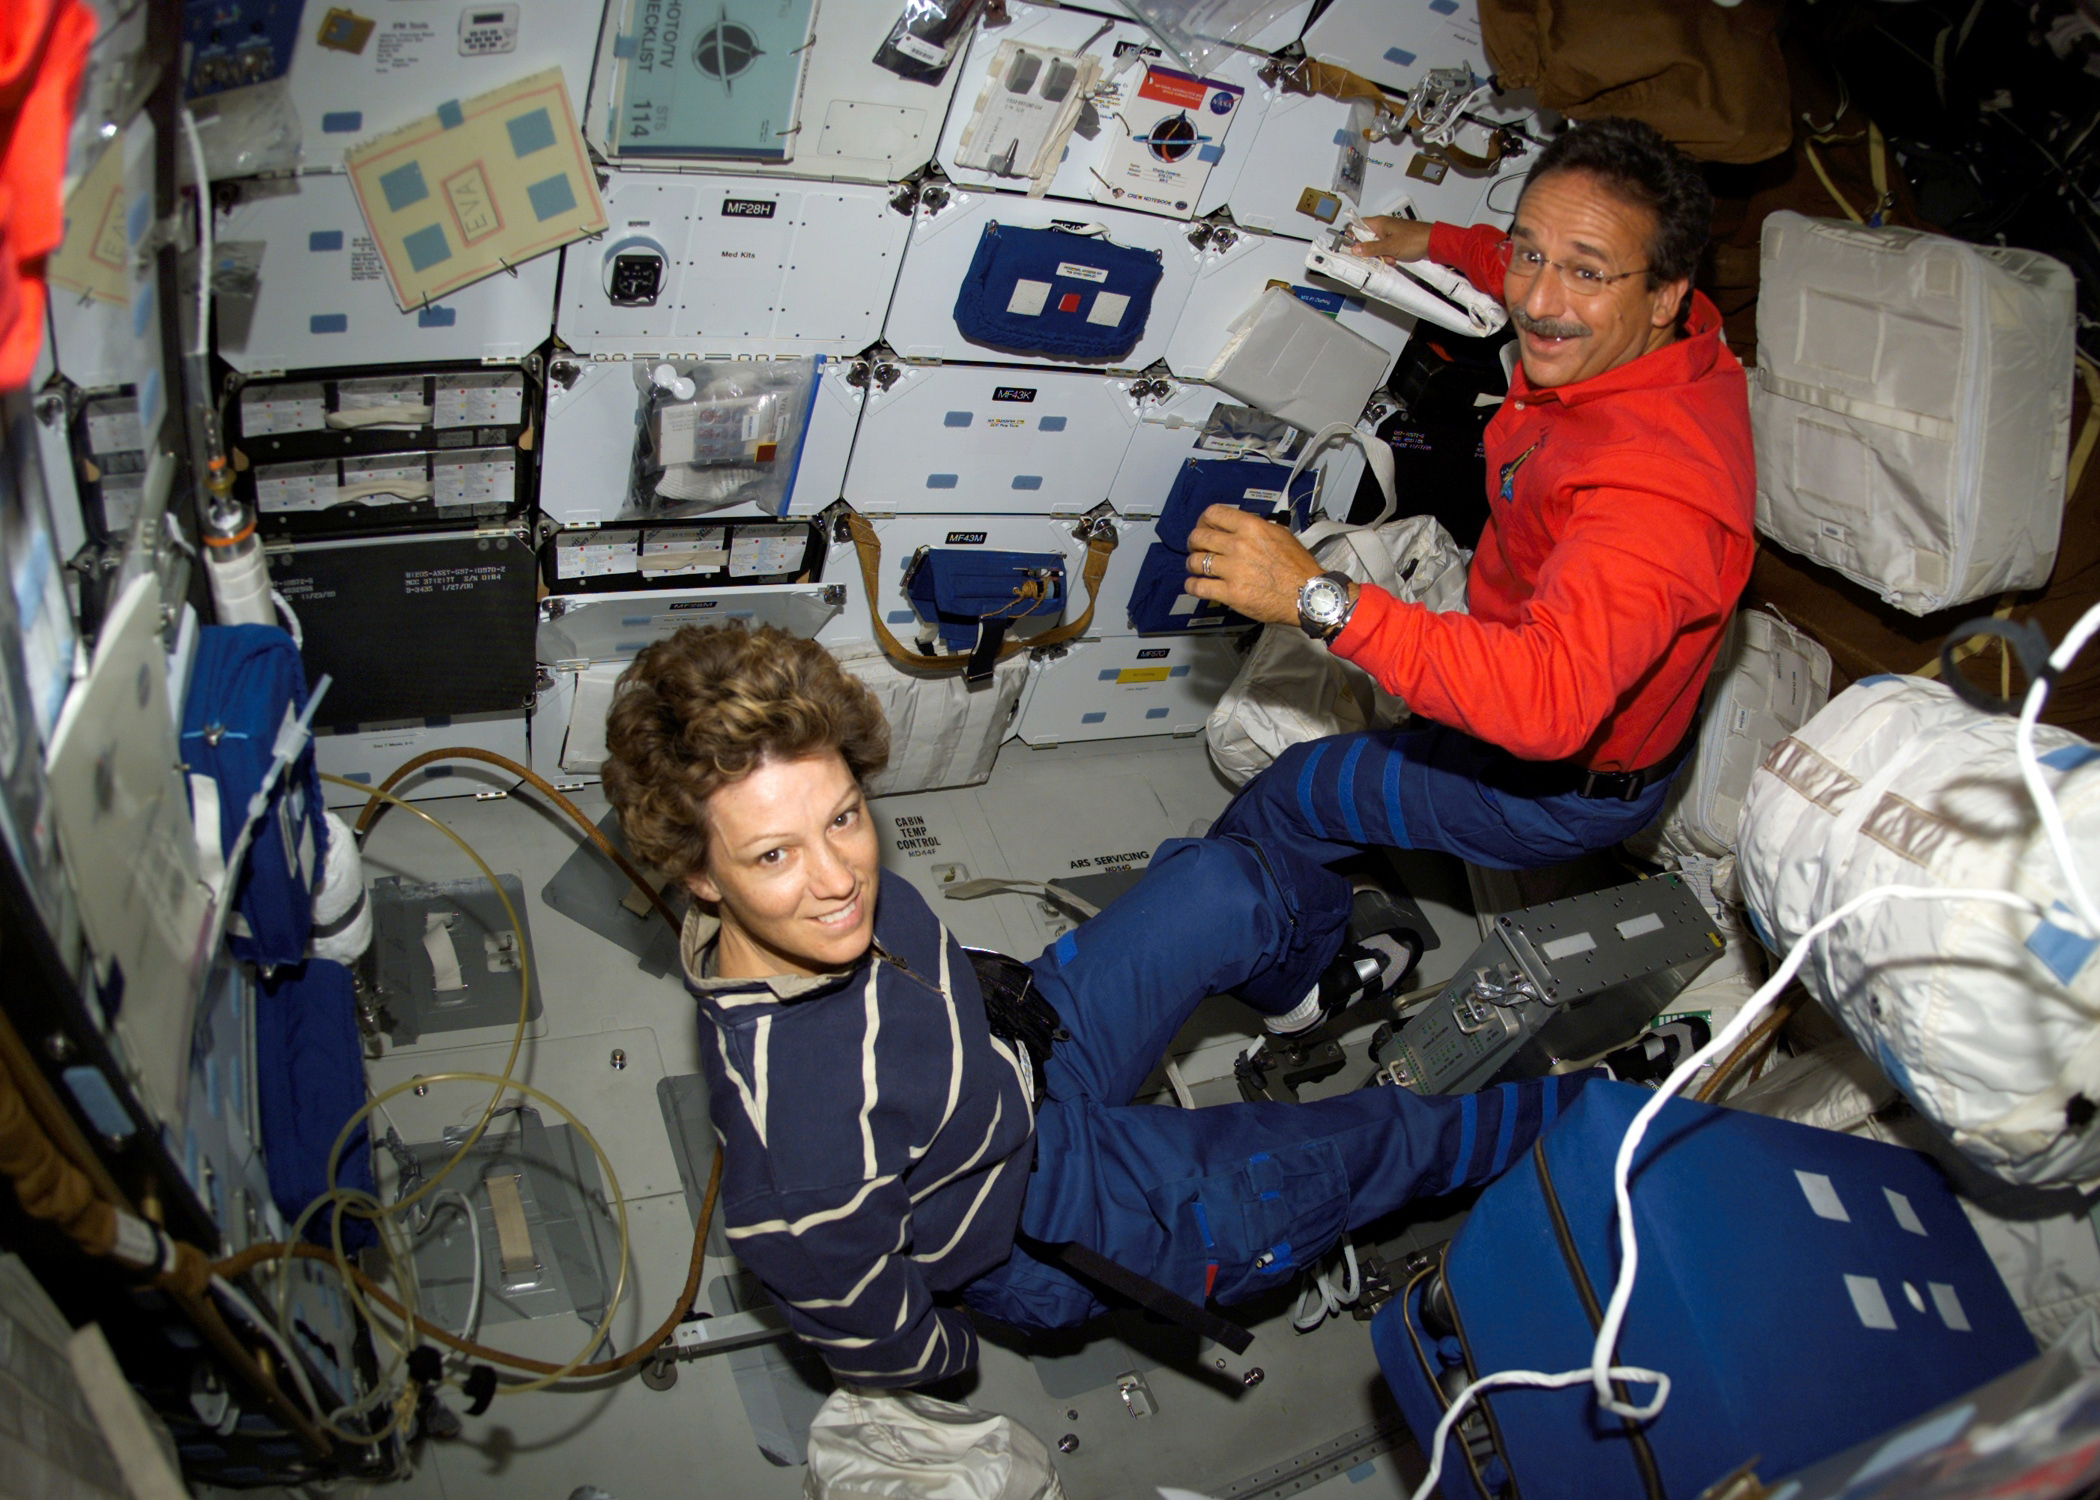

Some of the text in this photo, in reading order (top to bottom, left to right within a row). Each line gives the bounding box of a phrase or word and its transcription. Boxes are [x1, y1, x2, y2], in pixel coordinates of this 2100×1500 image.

[639, 0, 661, 73] ECKLIST
[1212, 98, 1232, 109] NASA
[631, 100, 652, 138] 114
[654, 105, 669, 132] STS
[455, 178, 488, 234] EVA
[1127, 193, 1172, 206] CREW NOTEBOOK
[727, 202, 771, 215] MF28H
[721, 251, 756, 259] Med Kits
[997, 389, 1032, 400] MF43K
[949, 533, 984, 542] MF43M
[895, 815, 925, 828] CABIN
[900, 826, 928, 839] TEMP
[896, 836, 942, 851] CONTROL
[1070, 850, 1150, 870] ARS SERVICING
